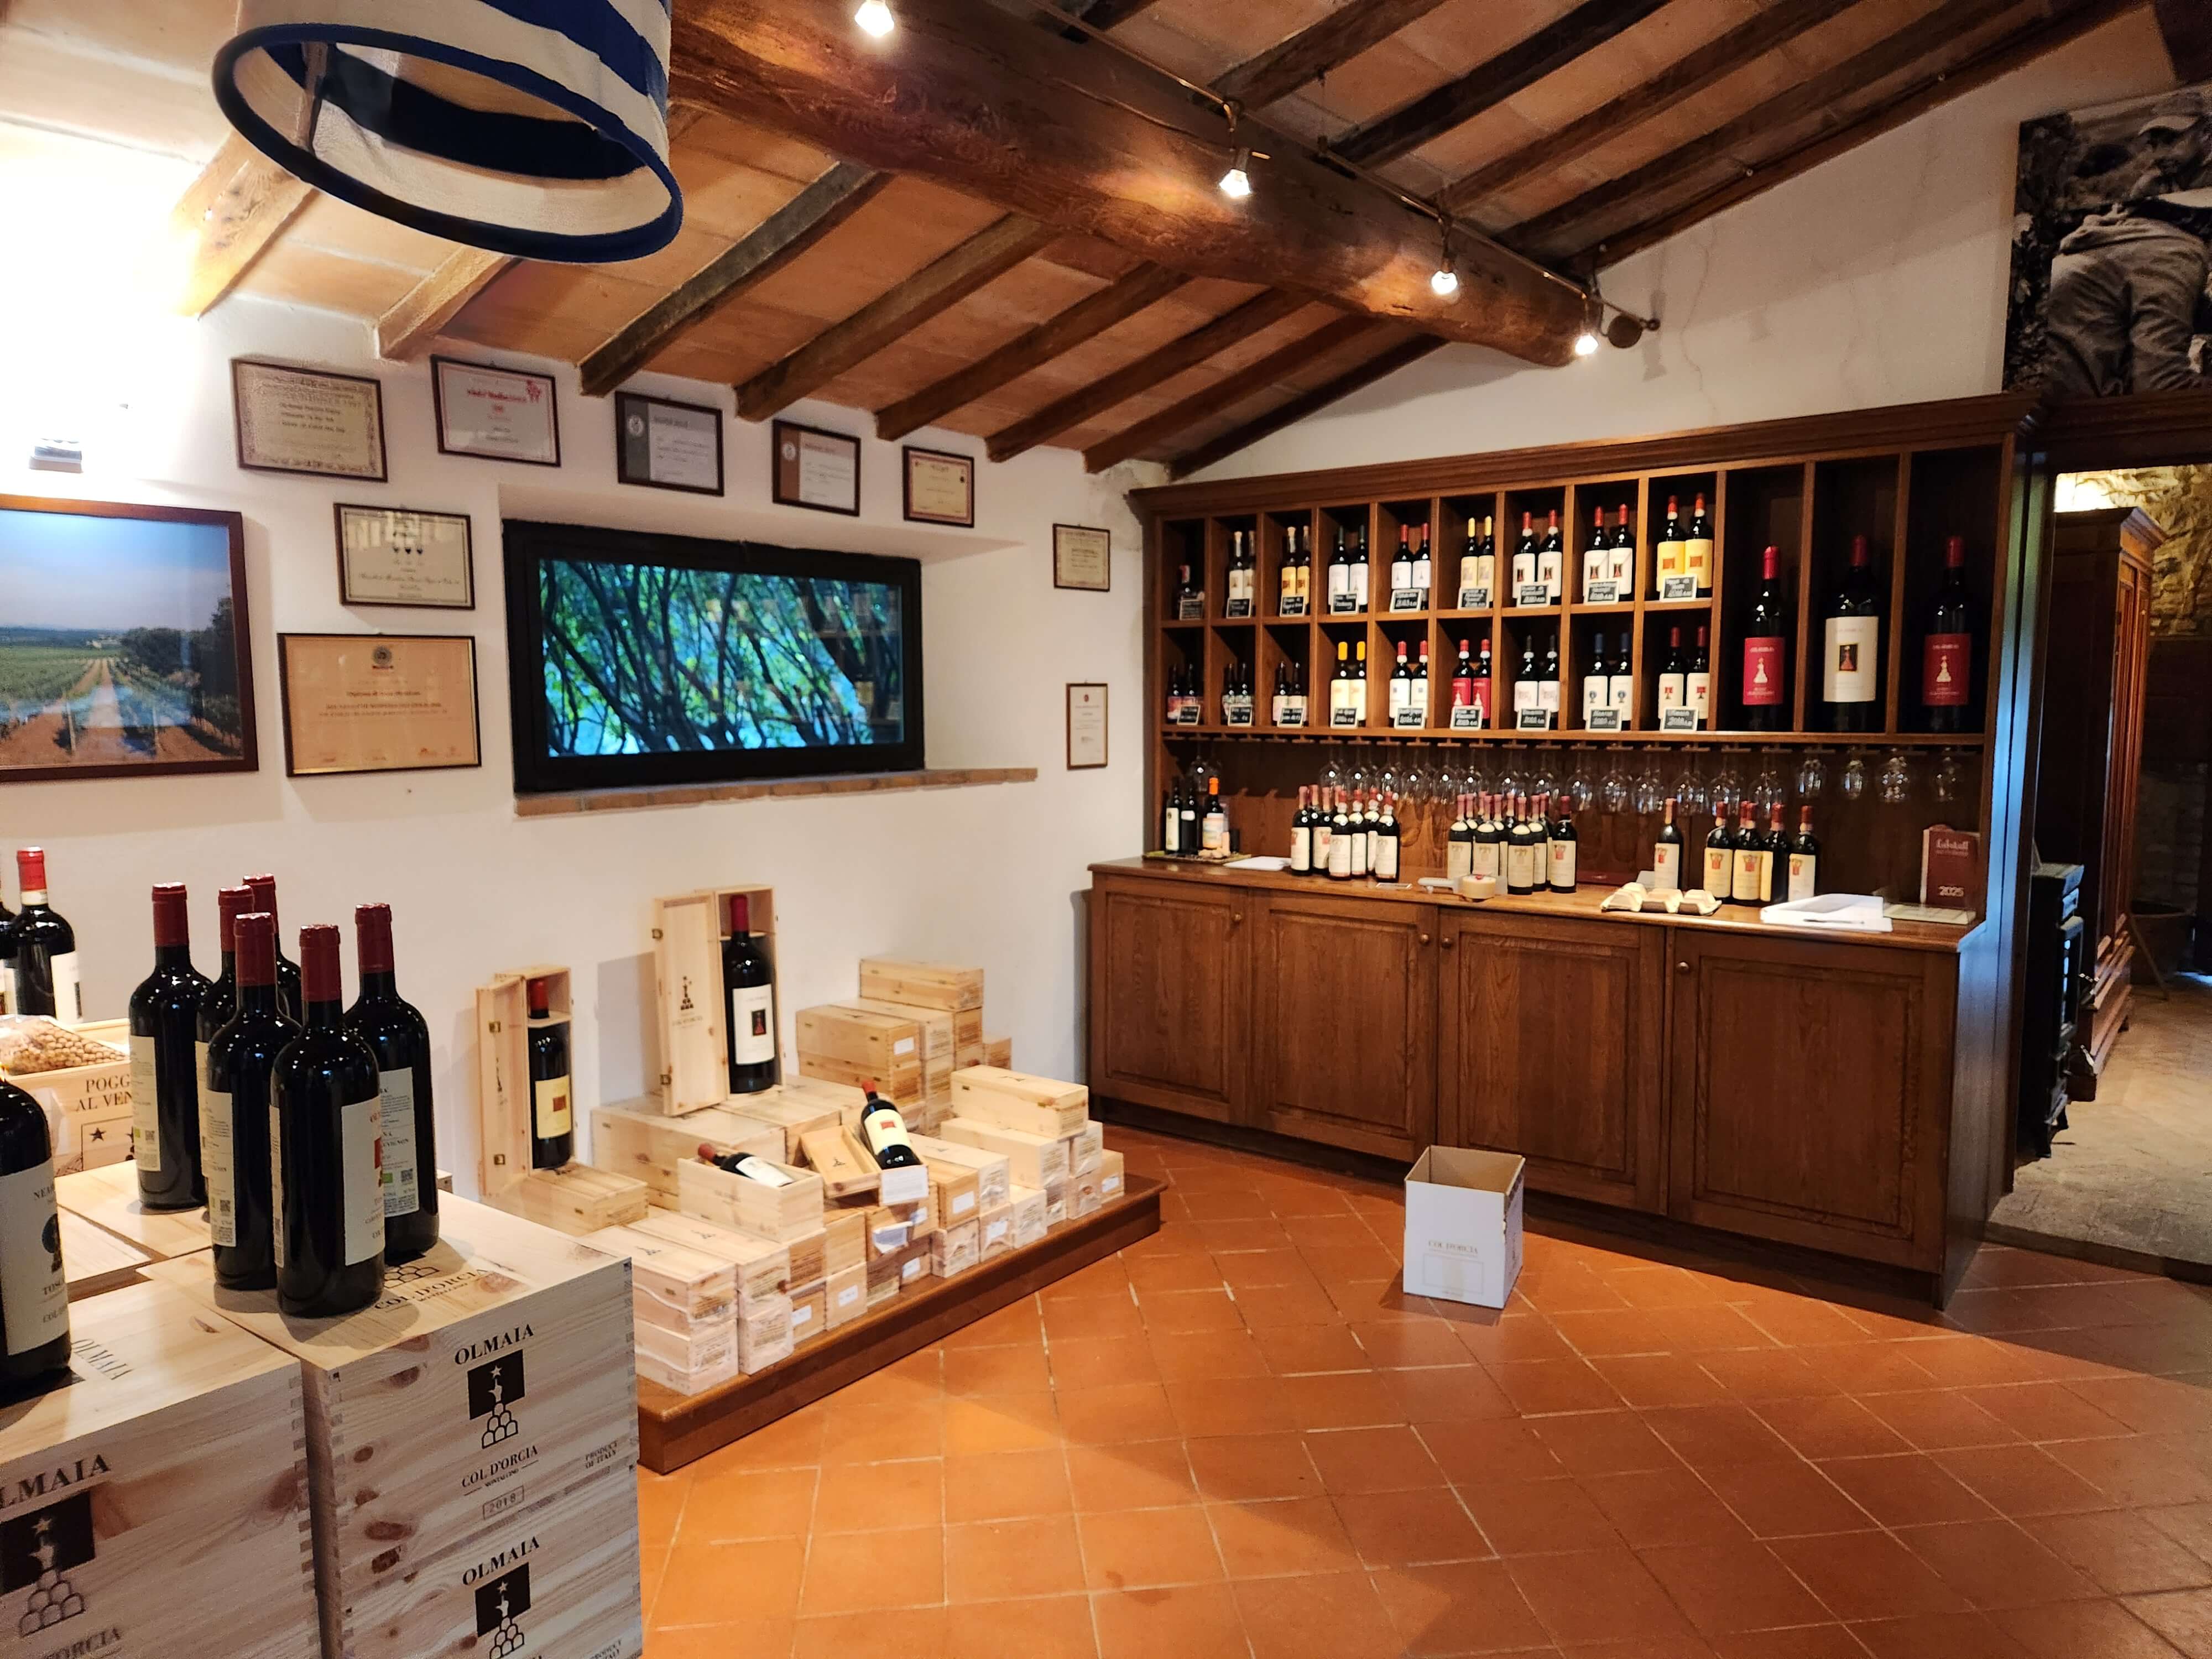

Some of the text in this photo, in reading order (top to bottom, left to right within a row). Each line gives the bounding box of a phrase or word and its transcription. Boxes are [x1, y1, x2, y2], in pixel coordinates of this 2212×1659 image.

[1938, 885, 1964, 896] 2025
[76, 1097, 97, 1110] AL
[374, 1269, 488, 1309] COL D'ORCIA
[455, 1323, 534, 1366] OLMAIA
[462, 1444, 538, 1488] COL D'ORCIA
[486, 1493, 517, 1514] 2018
[462, 1536, 540, 1587] OLMAIA
[44, 1628, 121, 1659] ORCIA
